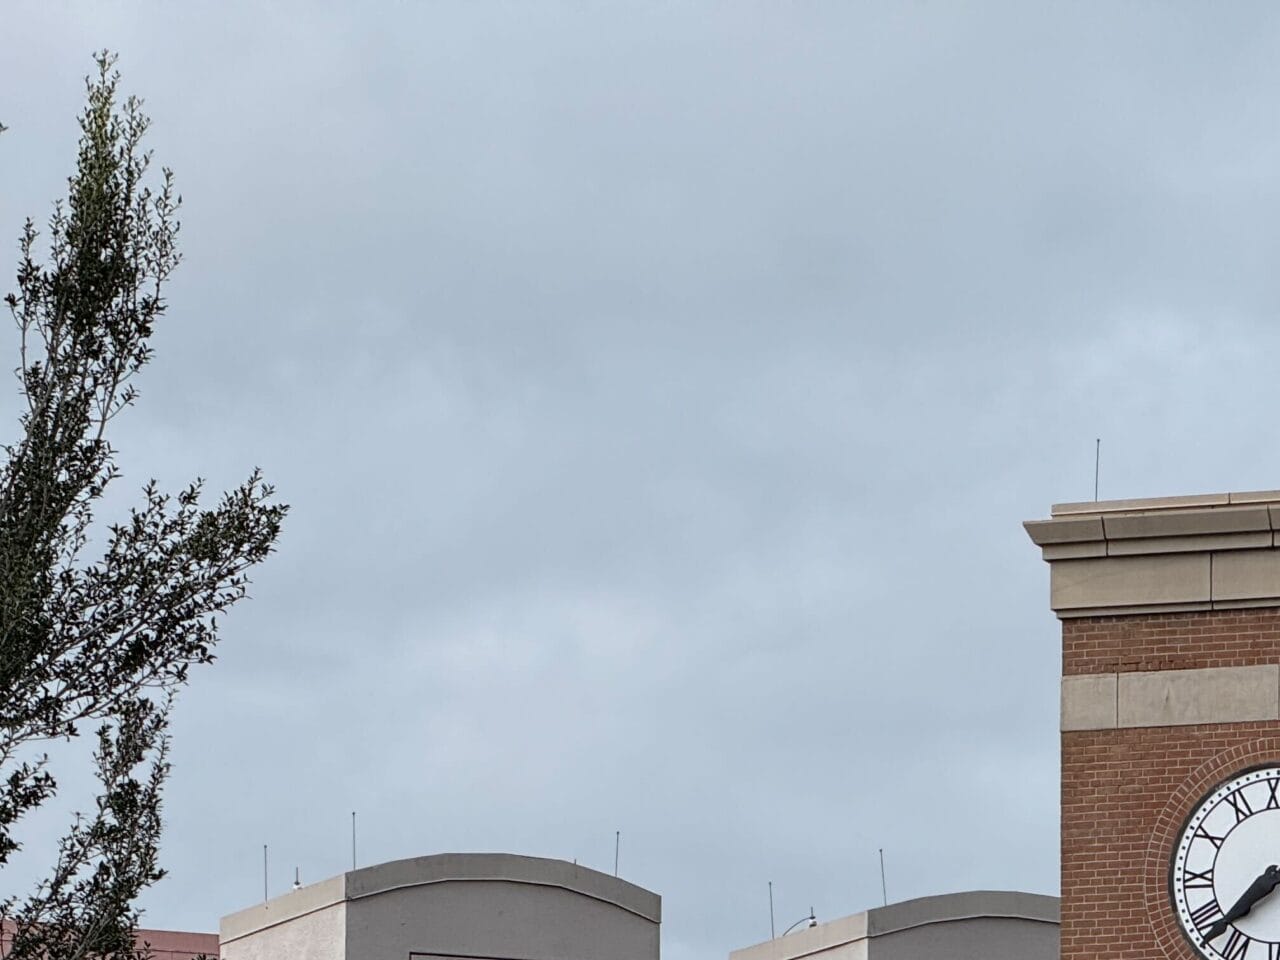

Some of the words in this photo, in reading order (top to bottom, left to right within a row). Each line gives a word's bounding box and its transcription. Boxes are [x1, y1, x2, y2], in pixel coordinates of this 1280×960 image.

[1224, 789, 1254, 824] XI
[1194, 825, 1225, 850] X
[1184, 868, 1214, 889] IX
